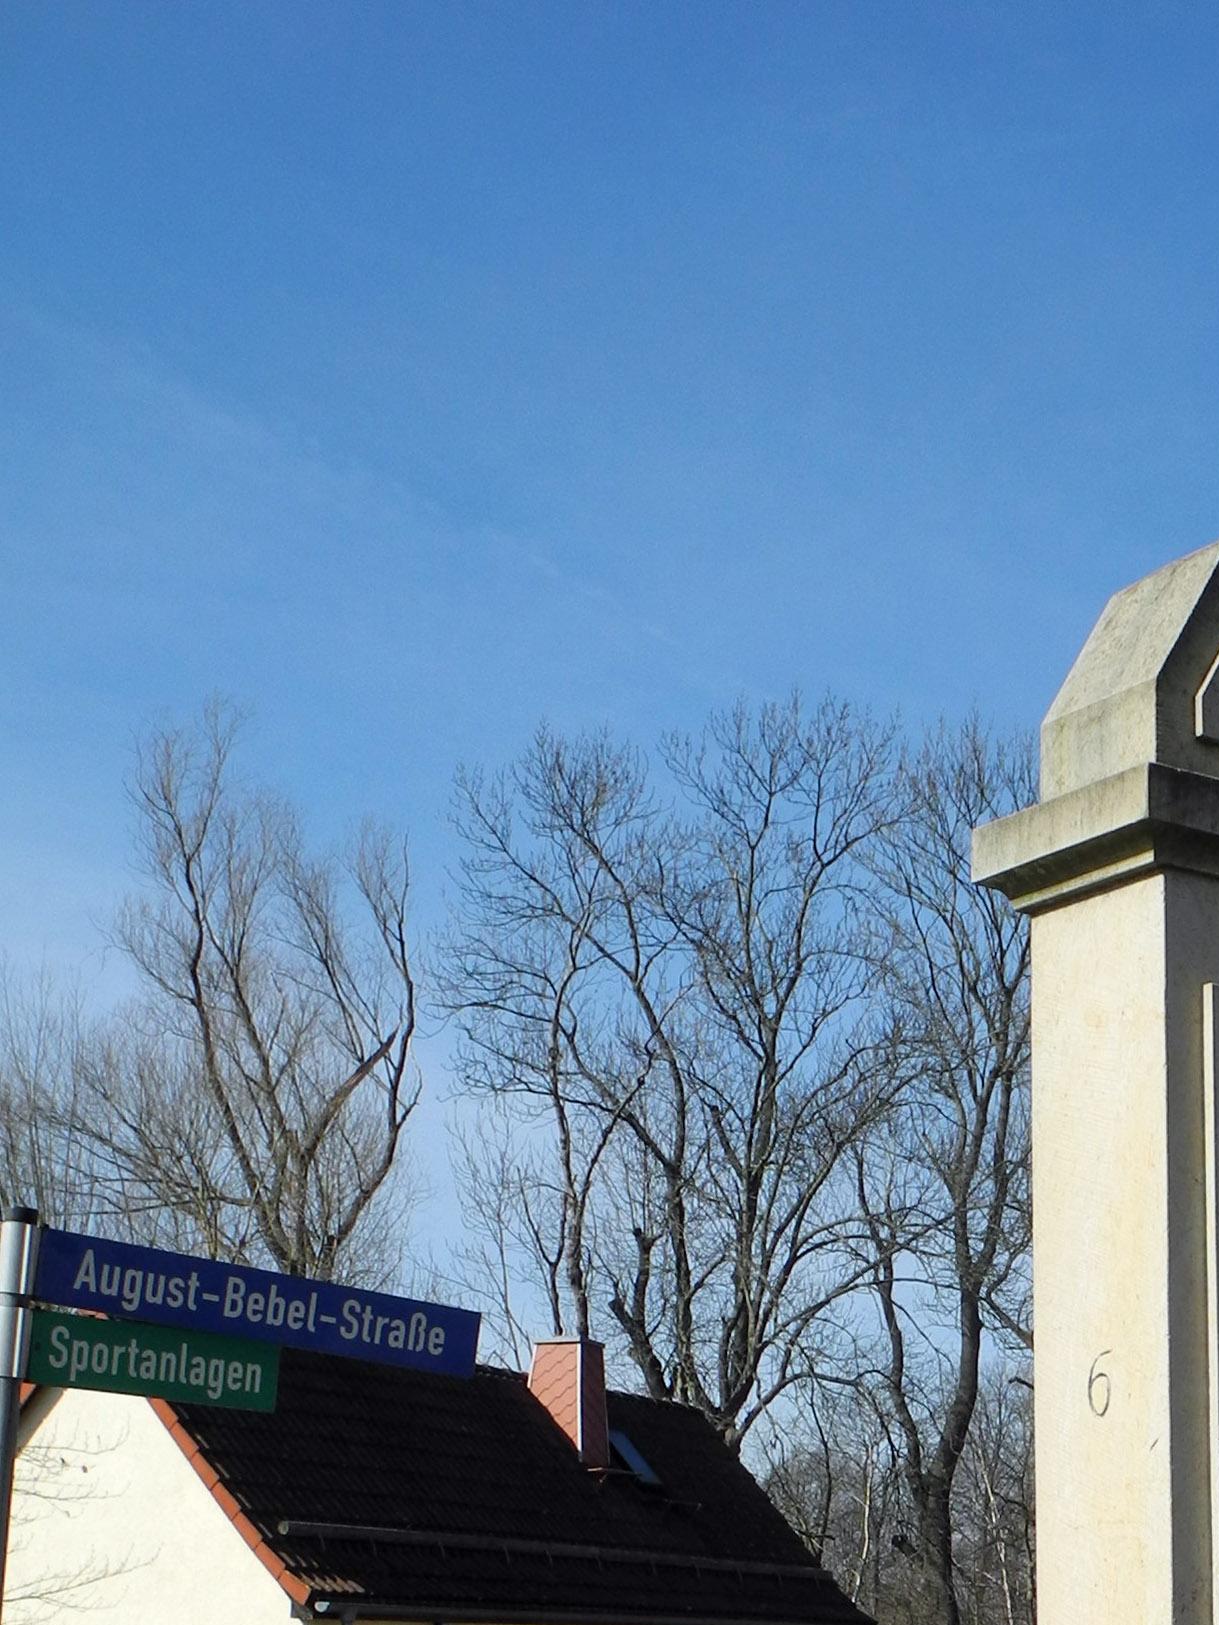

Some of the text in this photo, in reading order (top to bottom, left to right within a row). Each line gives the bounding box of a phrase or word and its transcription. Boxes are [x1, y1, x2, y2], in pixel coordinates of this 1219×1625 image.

[73, 1248, 447, 1356] August-Bebel-Straße
[47, 1325, 262, 1400] Sportanlagen
[1087, 1349, 1112, 1417] 6
